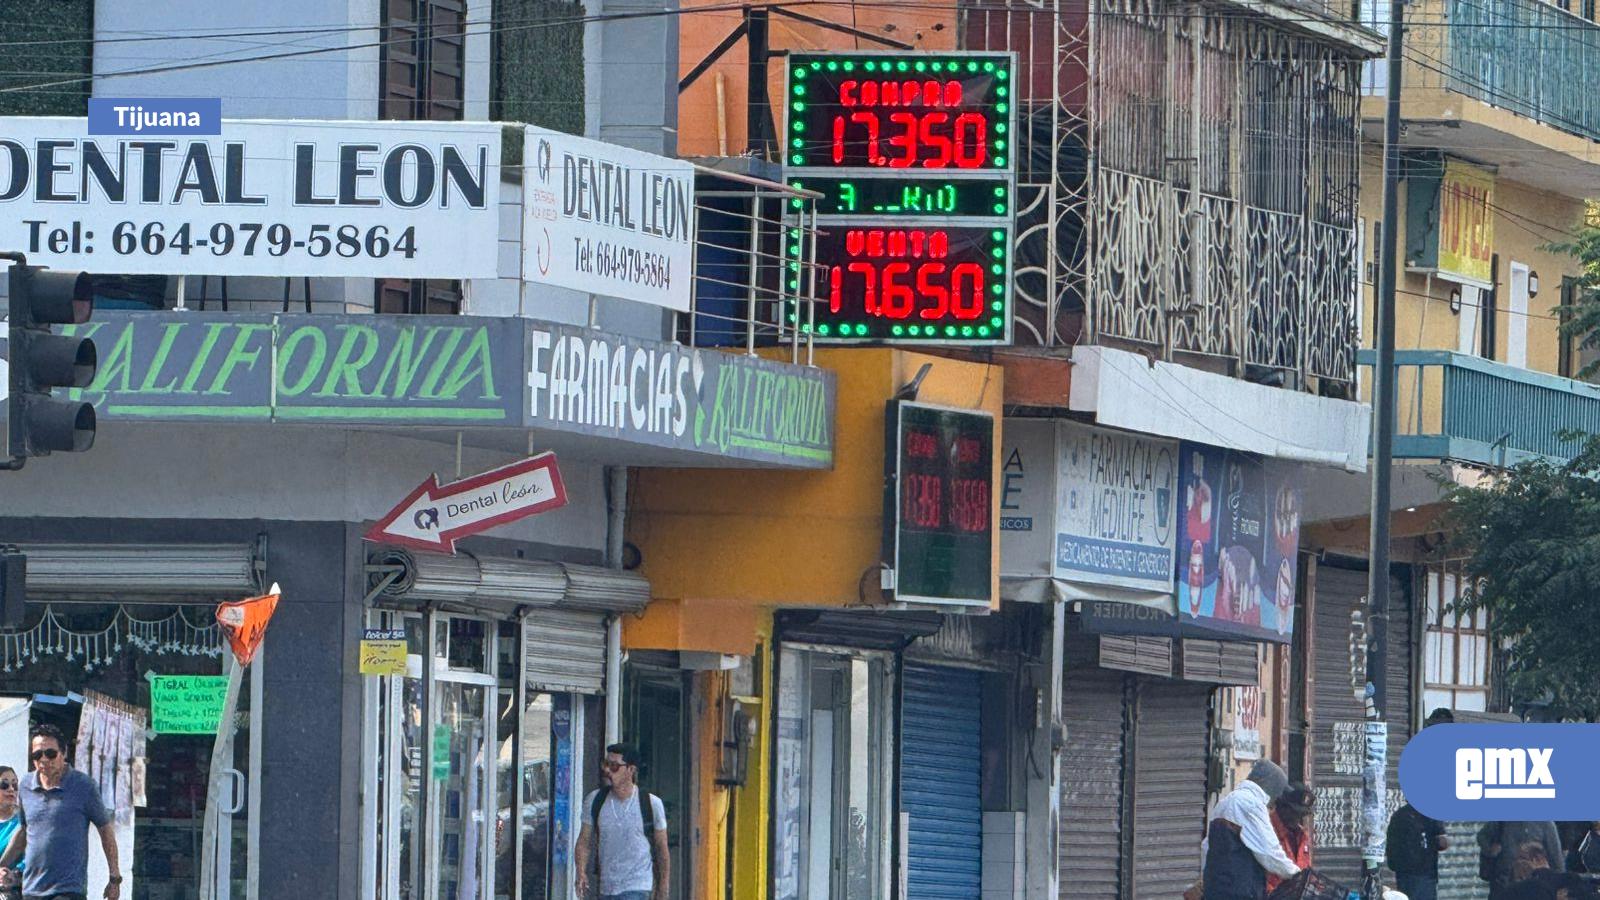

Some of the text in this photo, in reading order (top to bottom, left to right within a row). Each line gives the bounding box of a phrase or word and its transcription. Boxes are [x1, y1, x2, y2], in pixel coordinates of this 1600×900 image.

[840, 81, 962, 107] COMPRO
[832, 112, 986, 168] 17.350
[0, 139, 268, 206] DENTAL
[292, 142, 489, 210] LEON
[563, 153, 636, 231] DENTAL
[641, 171, 690, 243] LEON
[23, 219, 418, 259] Tel: 664-979-5864
[574, 237, 671, 290] Tel: 664-979-5864
[830, 262, 984, 319] 17.650
[528, 329, 829, 453] FARMACIAS KALIFORNIA
[1089, 433, 1153, 491] FARMACIA
[446, 491, 498, 518] Dental
[1089, 484, 1145, 542] MEDILIFE
